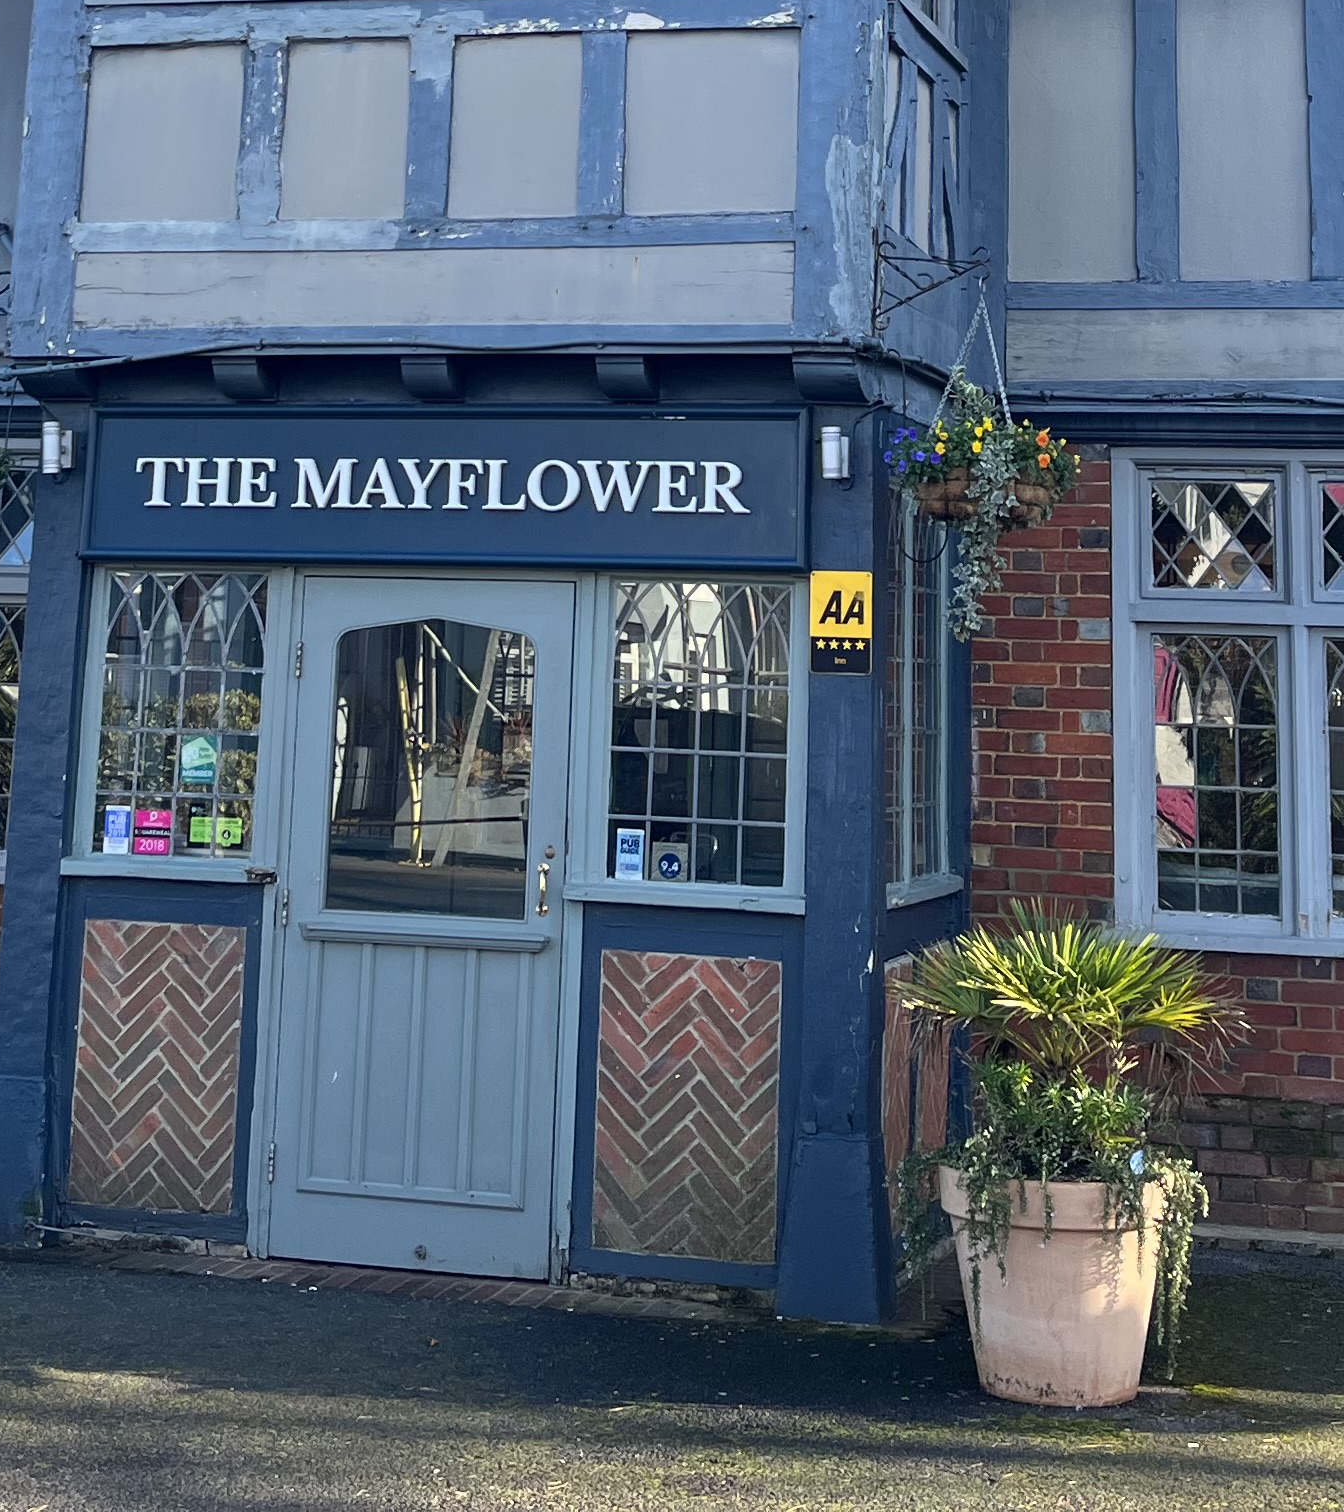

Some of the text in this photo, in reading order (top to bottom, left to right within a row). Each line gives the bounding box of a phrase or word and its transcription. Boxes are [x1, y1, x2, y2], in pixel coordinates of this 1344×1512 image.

[136, 457, 752, 515] THE MAYFLOWER
[818, 589, 865, 625] AA
[139, 839, 165, 851] 2018
[620, 838, 640, 847] PUB
[660, 860, 679, 872] 9.4
